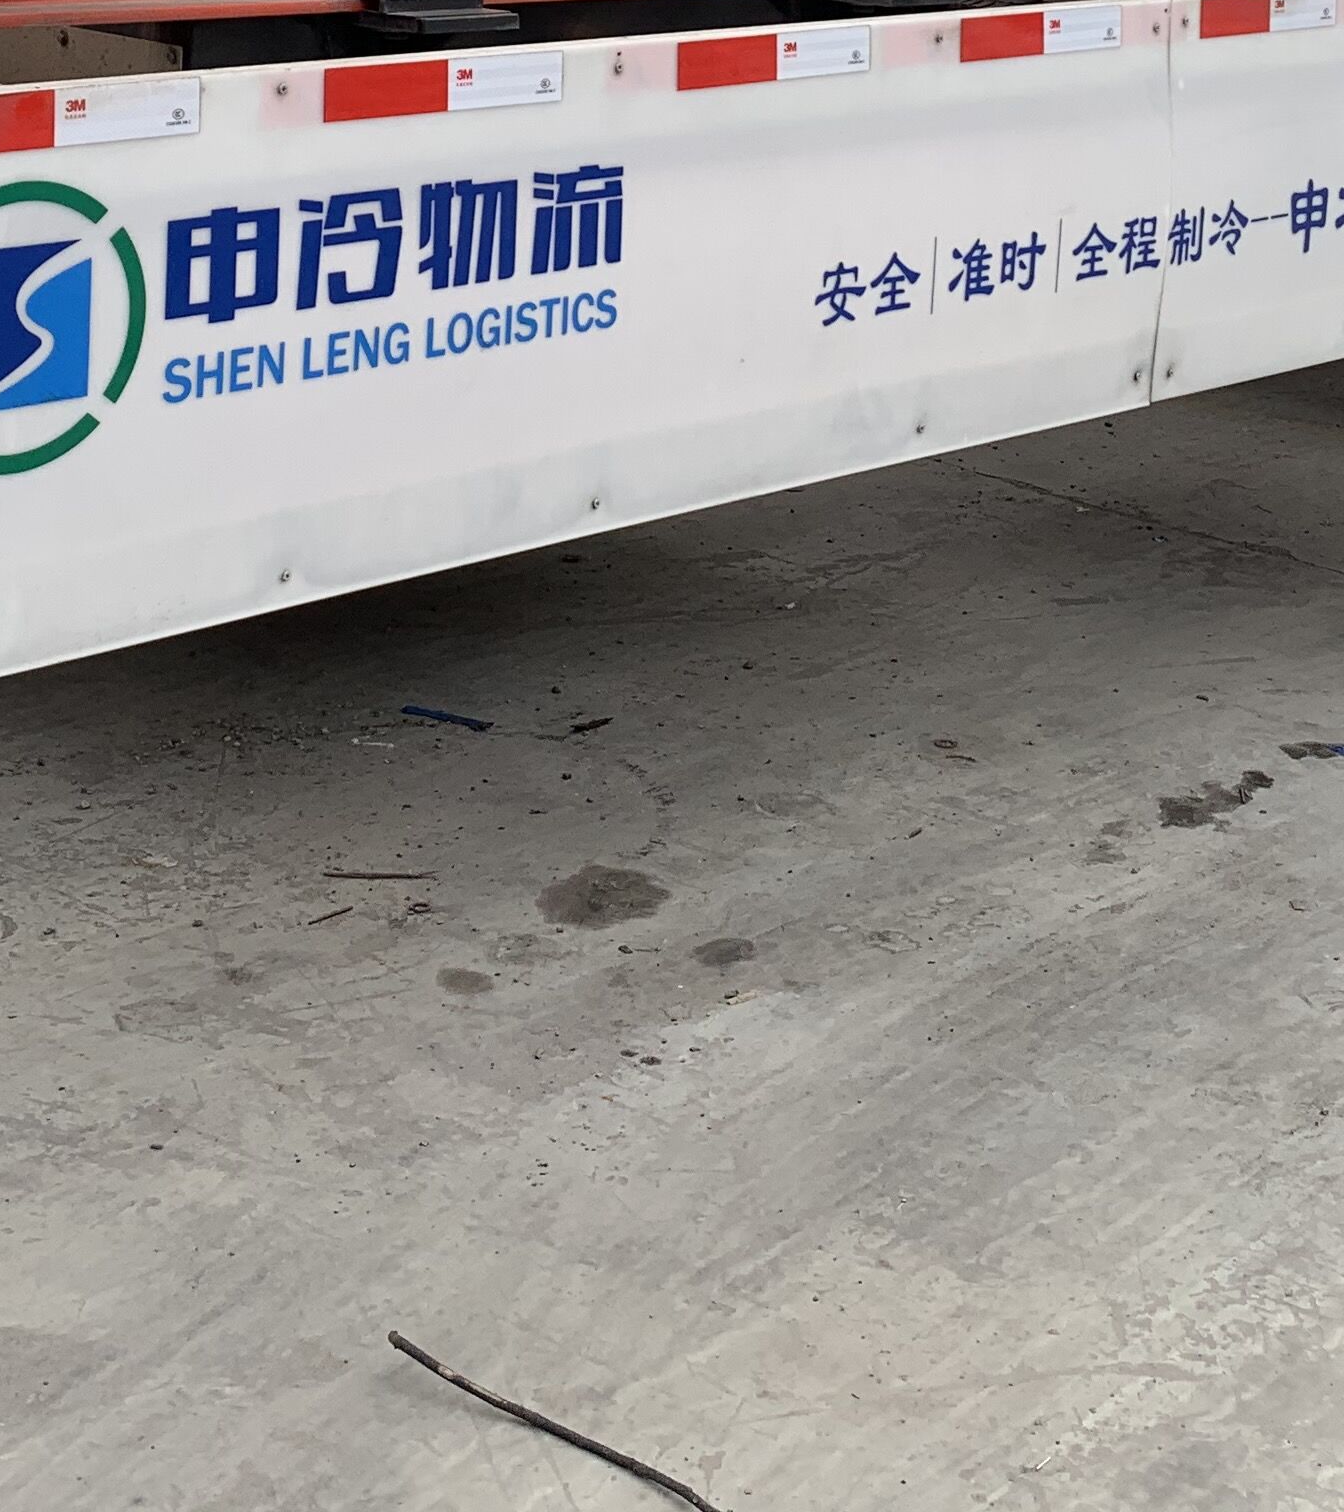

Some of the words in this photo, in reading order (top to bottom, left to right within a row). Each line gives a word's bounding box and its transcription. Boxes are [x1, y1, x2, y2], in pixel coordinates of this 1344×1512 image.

[1274, 0, 1285, 9] 3M
[1049, 19, 1061, 30] 3M
[783, 41, 797, 52] 3M
[455, 68, 473, 80] 3M
[64, 98, 87, 112] 3M
[164, 164, 624, 324] 申冷物流
[162, 341, 285, 403] SHEN
[302, 322, 409, 380] LENG
[425, 289, 618, 359] LOGISTICS
